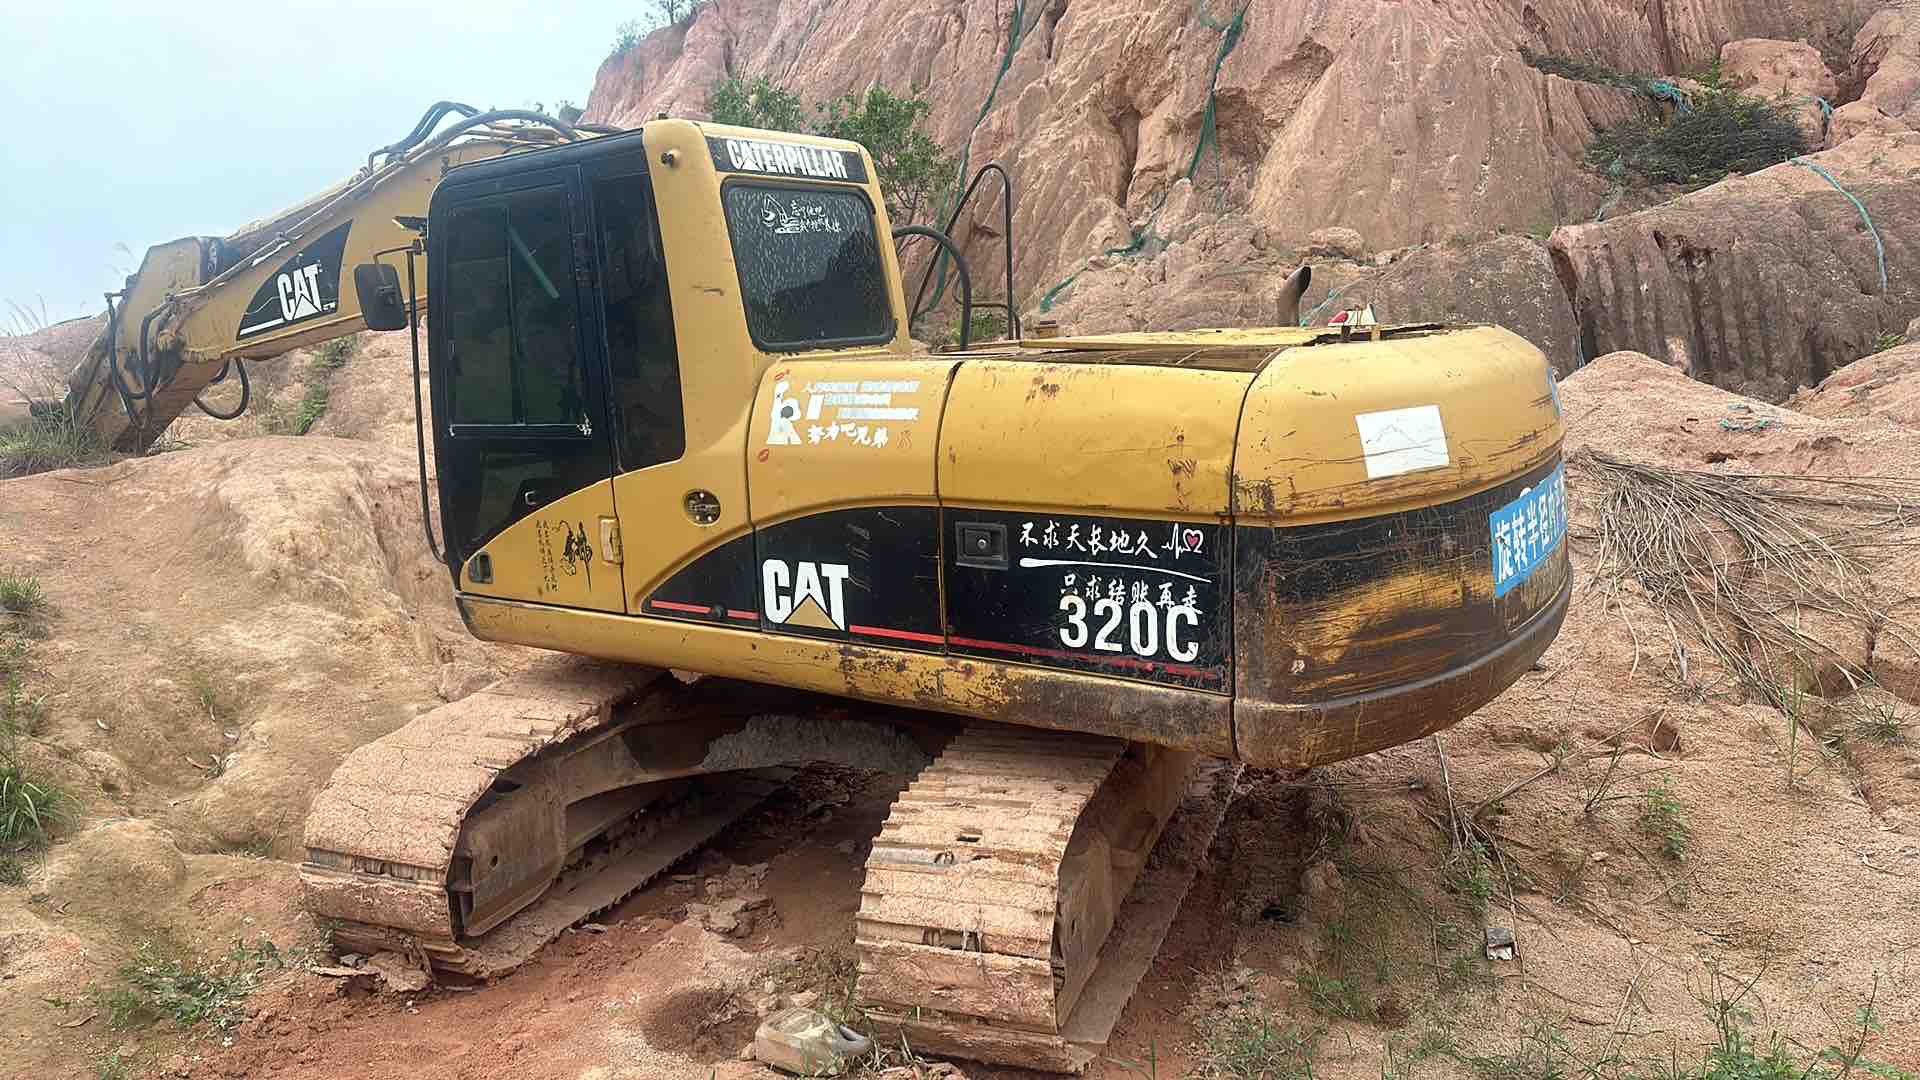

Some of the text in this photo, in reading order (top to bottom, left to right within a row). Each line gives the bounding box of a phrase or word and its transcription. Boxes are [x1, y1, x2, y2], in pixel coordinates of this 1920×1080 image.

[726, 140, 848, 179] CATERPILLAR
[277, 263, 322, 321] CAT
[1019, 519, 1158, 559] 不求天长地久
[762, 559, 850, 631] CAT
[1060, 573, 1203, 616] 只求结账再走
[1059, 594, 1200, 663] 320C
